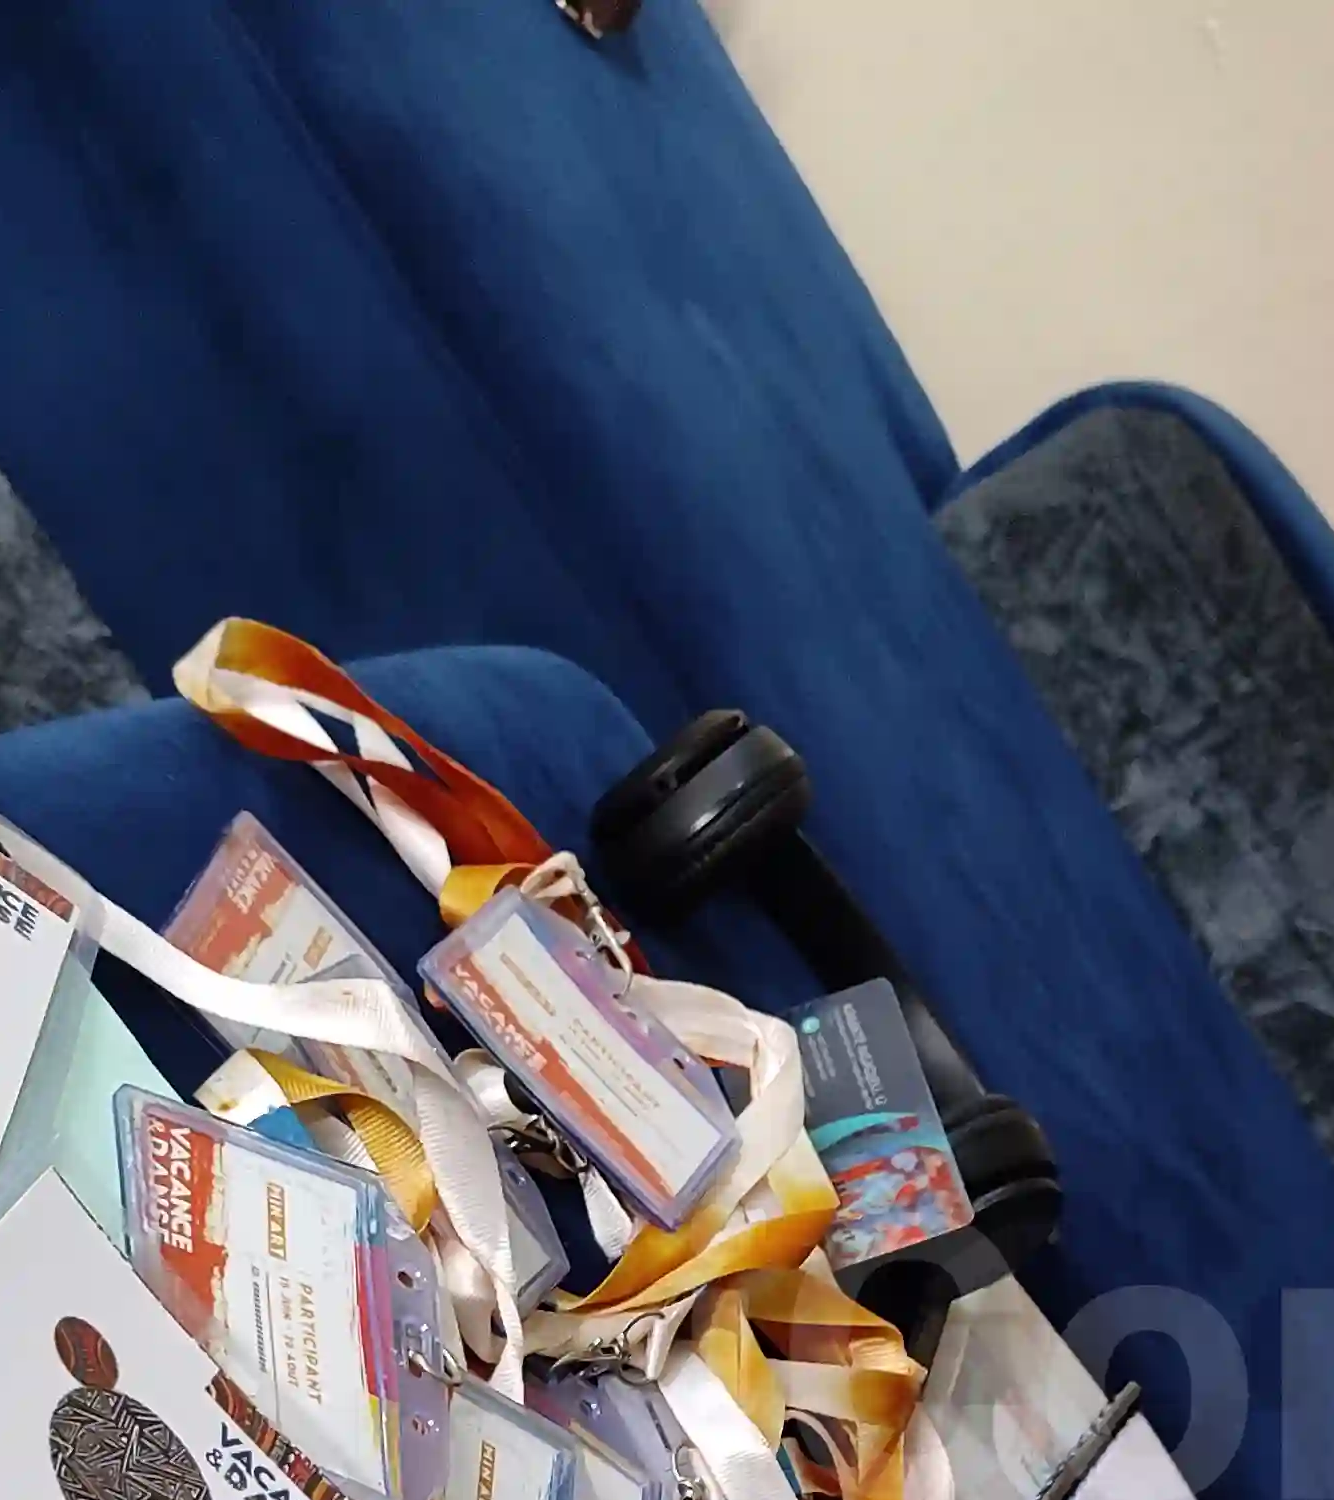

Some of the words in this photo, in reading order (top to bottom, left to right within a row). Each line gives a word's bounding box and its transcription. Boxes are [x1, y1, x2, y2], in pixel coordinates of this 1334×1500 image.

[169, 1126, 193, 1254] VACANCE
[301, 1281, 323, 1405] PARTICIPANT
[205, 1449, 224, 1471] &
